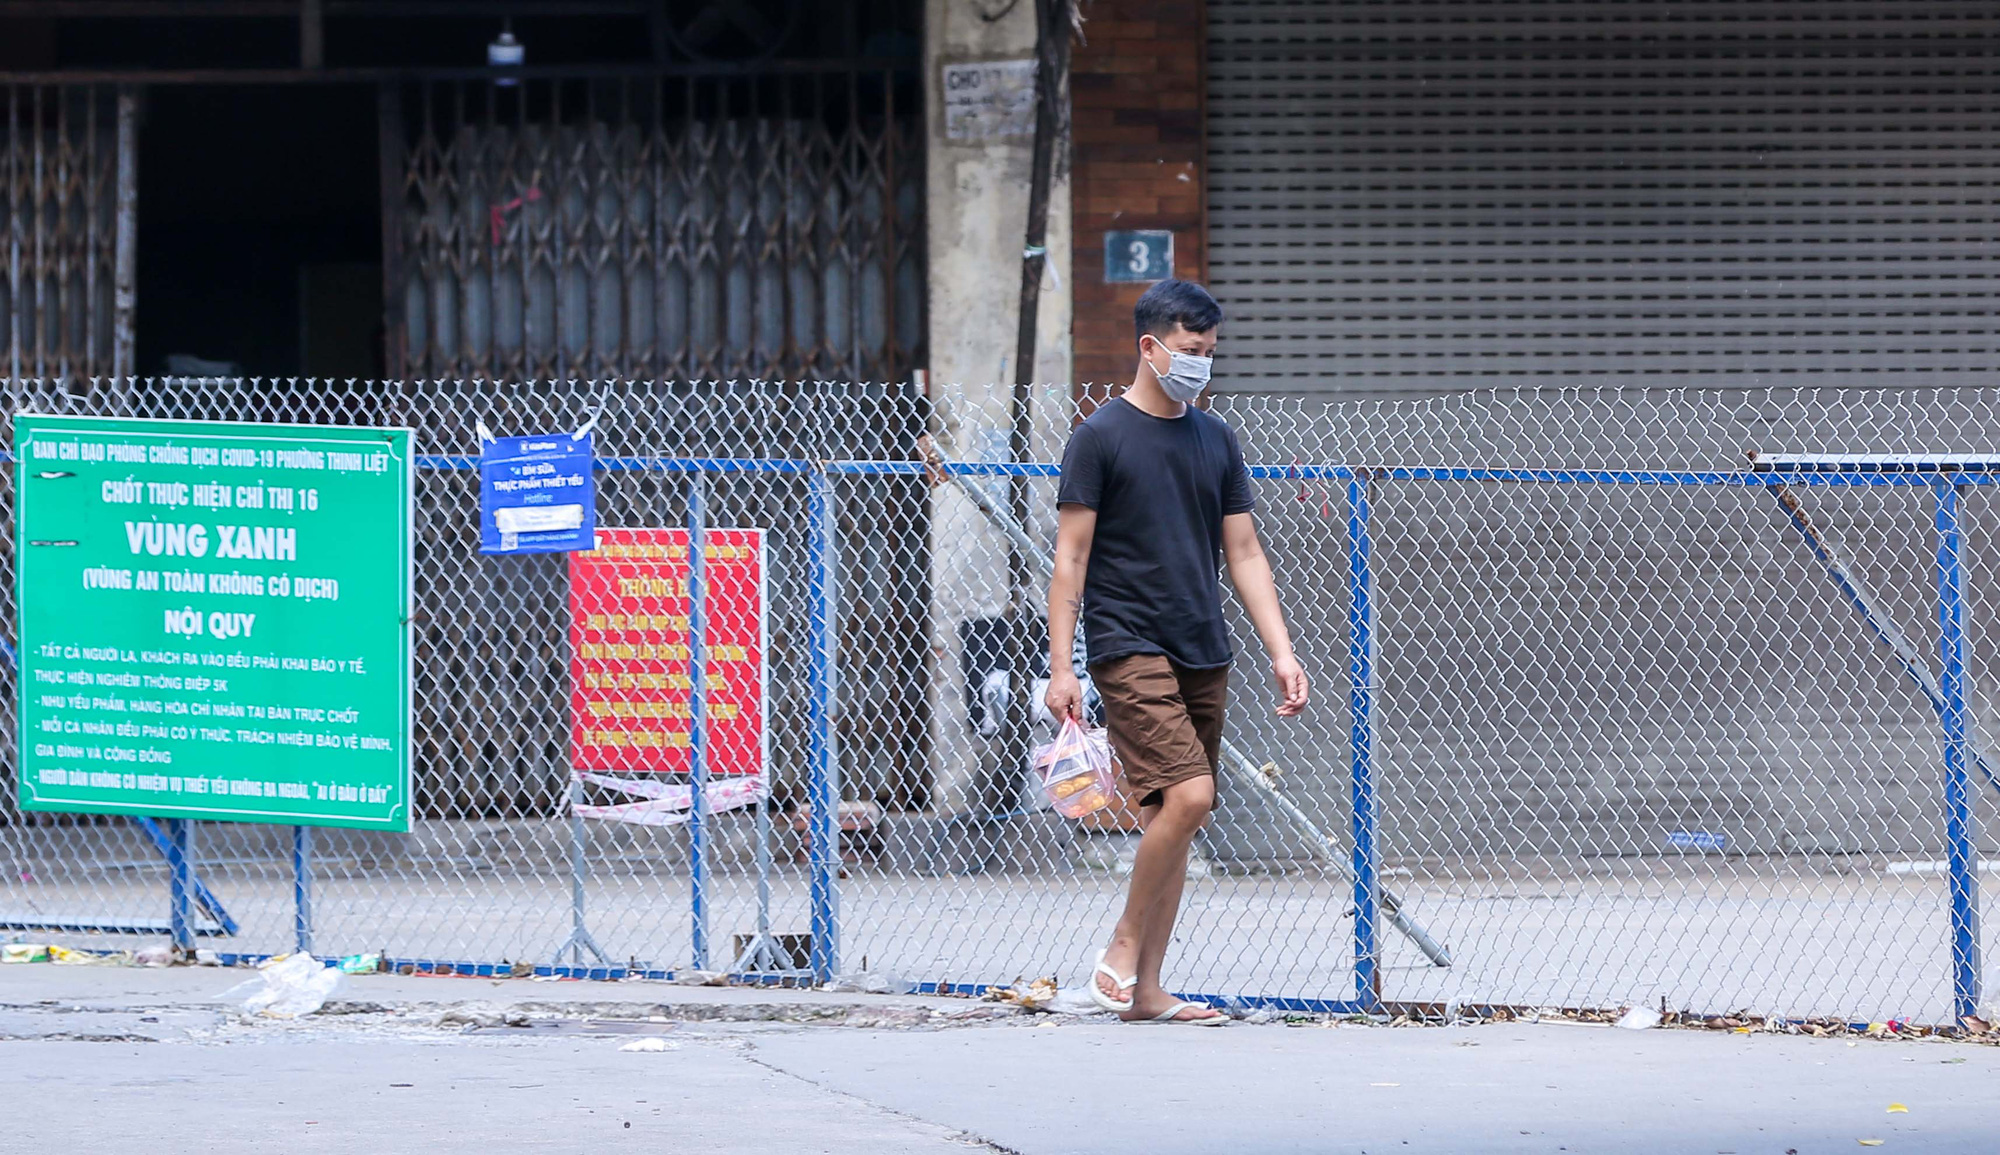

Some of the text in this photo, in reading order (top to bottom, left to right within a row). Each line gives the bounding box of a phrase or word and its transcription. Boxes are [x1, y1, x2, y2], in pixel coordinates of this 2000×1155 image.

[1129, 240, 1149, 273] 3
[33, 440, 57, 459] BAN
[59, 437, 79, 460] CHỈ
[107, 440, 147, 463] PHÒNG
[149, 440, 189, 465] CHỐNG
[191, 447, 219, 469] DỊCH
[221, 448, 274, 468] COVID-19
[327, 452, 362, 475] THỊNH
[364, 450, 389, 476] LIỆT
[102, 474, 318, 515] CHỐT THỰC HIỆN CHỈ THỊ 16
[124, 515, 296, 561] VÙNG XANH
[83, 564, 339, 602] (VÙNG AN TOÀN KHÔNG CÓ DỊCH)
[618, 574, 674, 597] THÔNG
[164, 605, 256, 640] NỘI QUY
[40, 641, 62, 658] TẤT
[64, 642, 80, 659] CẢ
[141, 648, 181, 664] KHÁCH
[183, 652, 199, 665] RA
[200, 651, 225, 667] VÀO
[253, 652, 279, 669] PHẢI
[282, 657, 309, 671] KHAI
[338, 660, 346, 673] Y
[67, 669, 94, 686] HIỆN
[213, 679, 228, 692] 5K
[67, 692, 91, 710] YẾU
[190, 698, 211, 716] CHỈ
[327, 706, 360, 724] CHỐT
[142, 721, 169, 739] PHẢI
[316, 730, 341, 748] BẢO
[35, 743, 55, 756] GIA
[85, 744, 102, 759] VÀ
